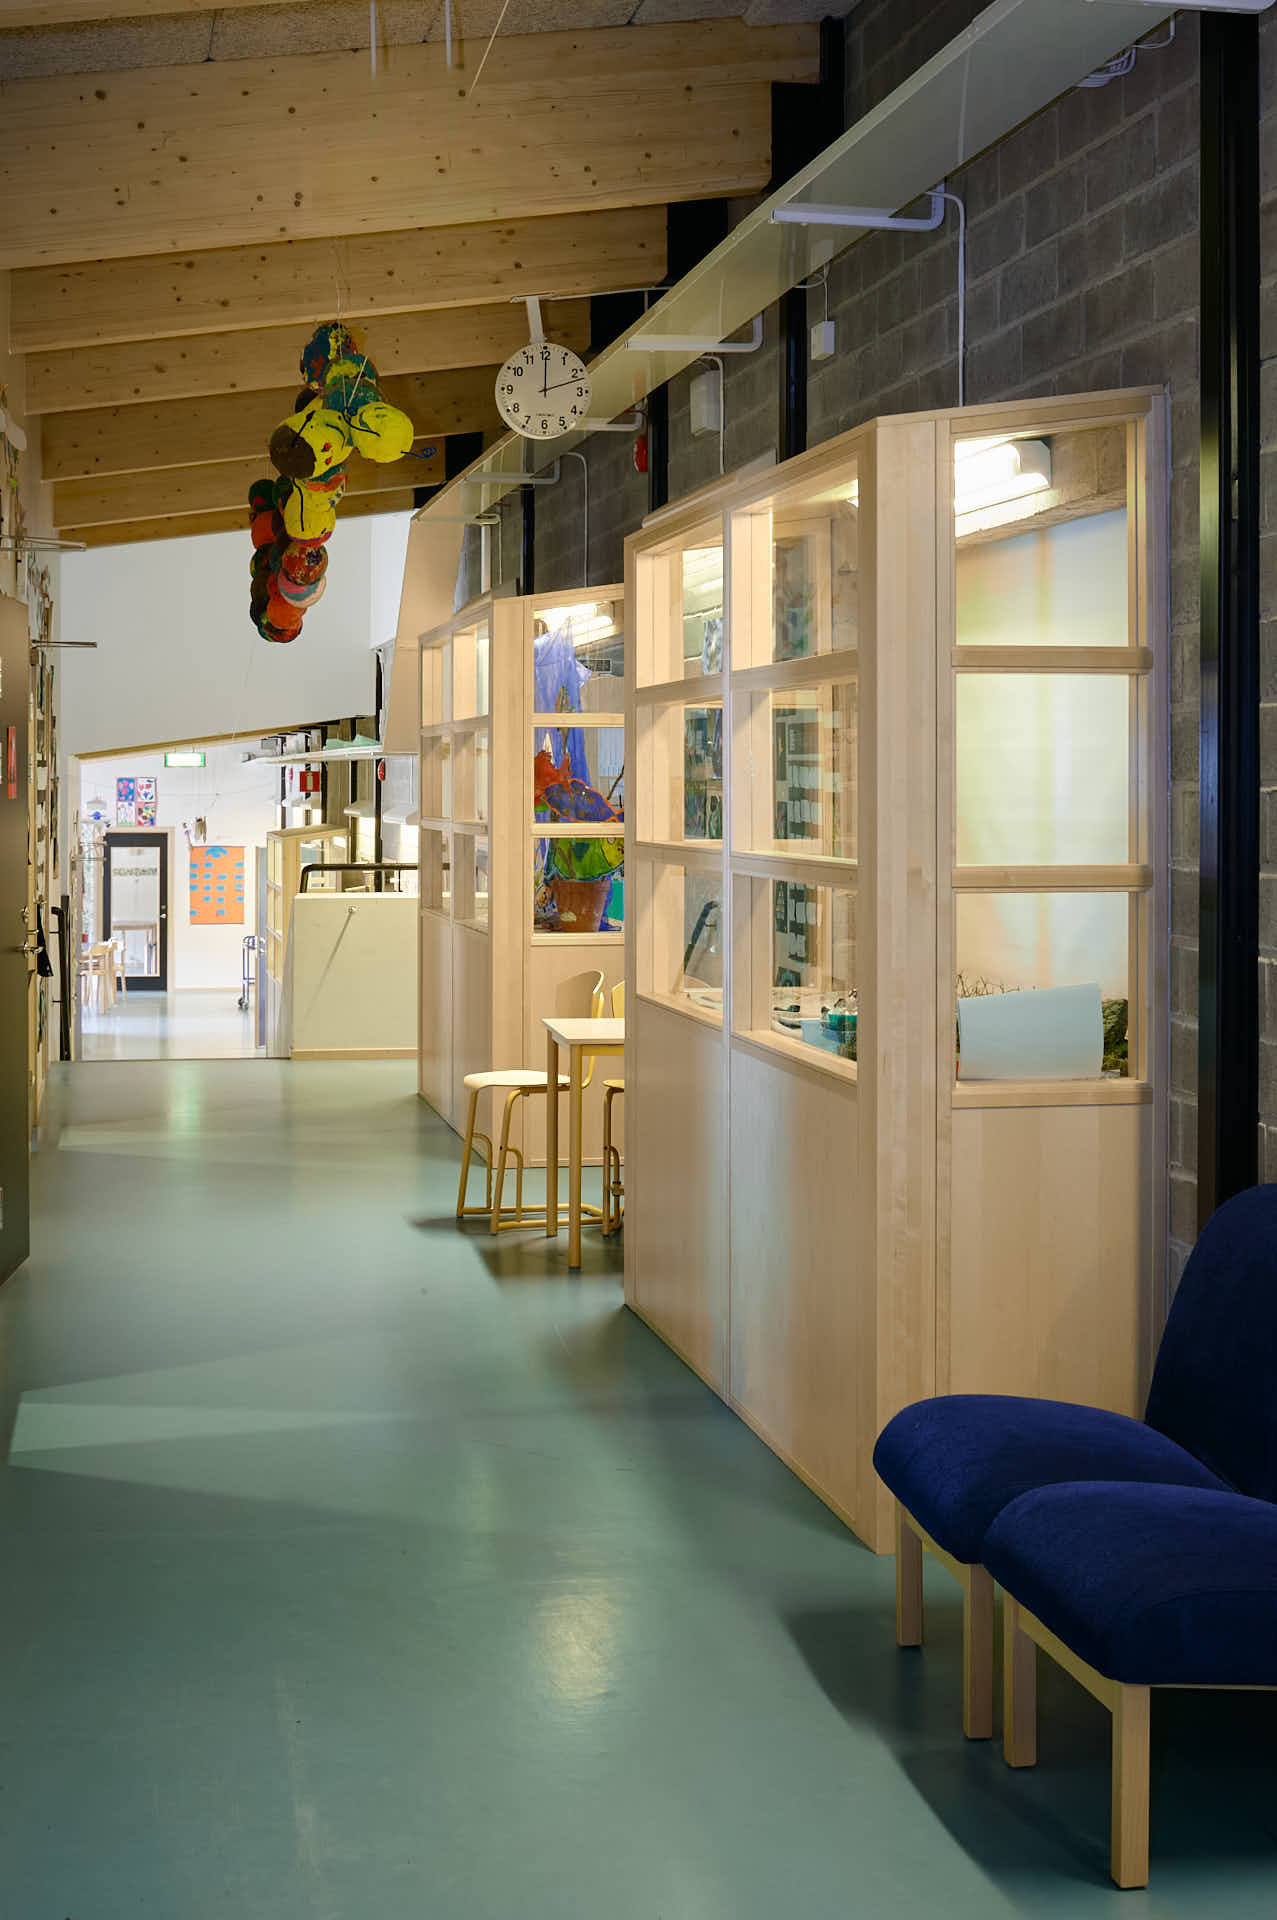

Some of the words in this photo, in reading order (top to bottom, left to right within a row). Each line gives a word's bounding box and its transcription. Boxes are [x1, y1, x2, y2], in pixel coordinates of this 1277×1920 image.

[525, 355, 534, 364] 11
[540, 351, 551, 360] 12
[512, 367, 523, 376] 10
[571, 368, 578, 378] 2
[506, 385, 513, 394] 9
[576, 387, 583, 397] 3
[513, 403, 519, 413] 8
[571, 405, 577, 415] 4
[525, 416, 531, 424] 7
[542, 420, 548, 429] 6
[559, 417, 565, 426] 5
